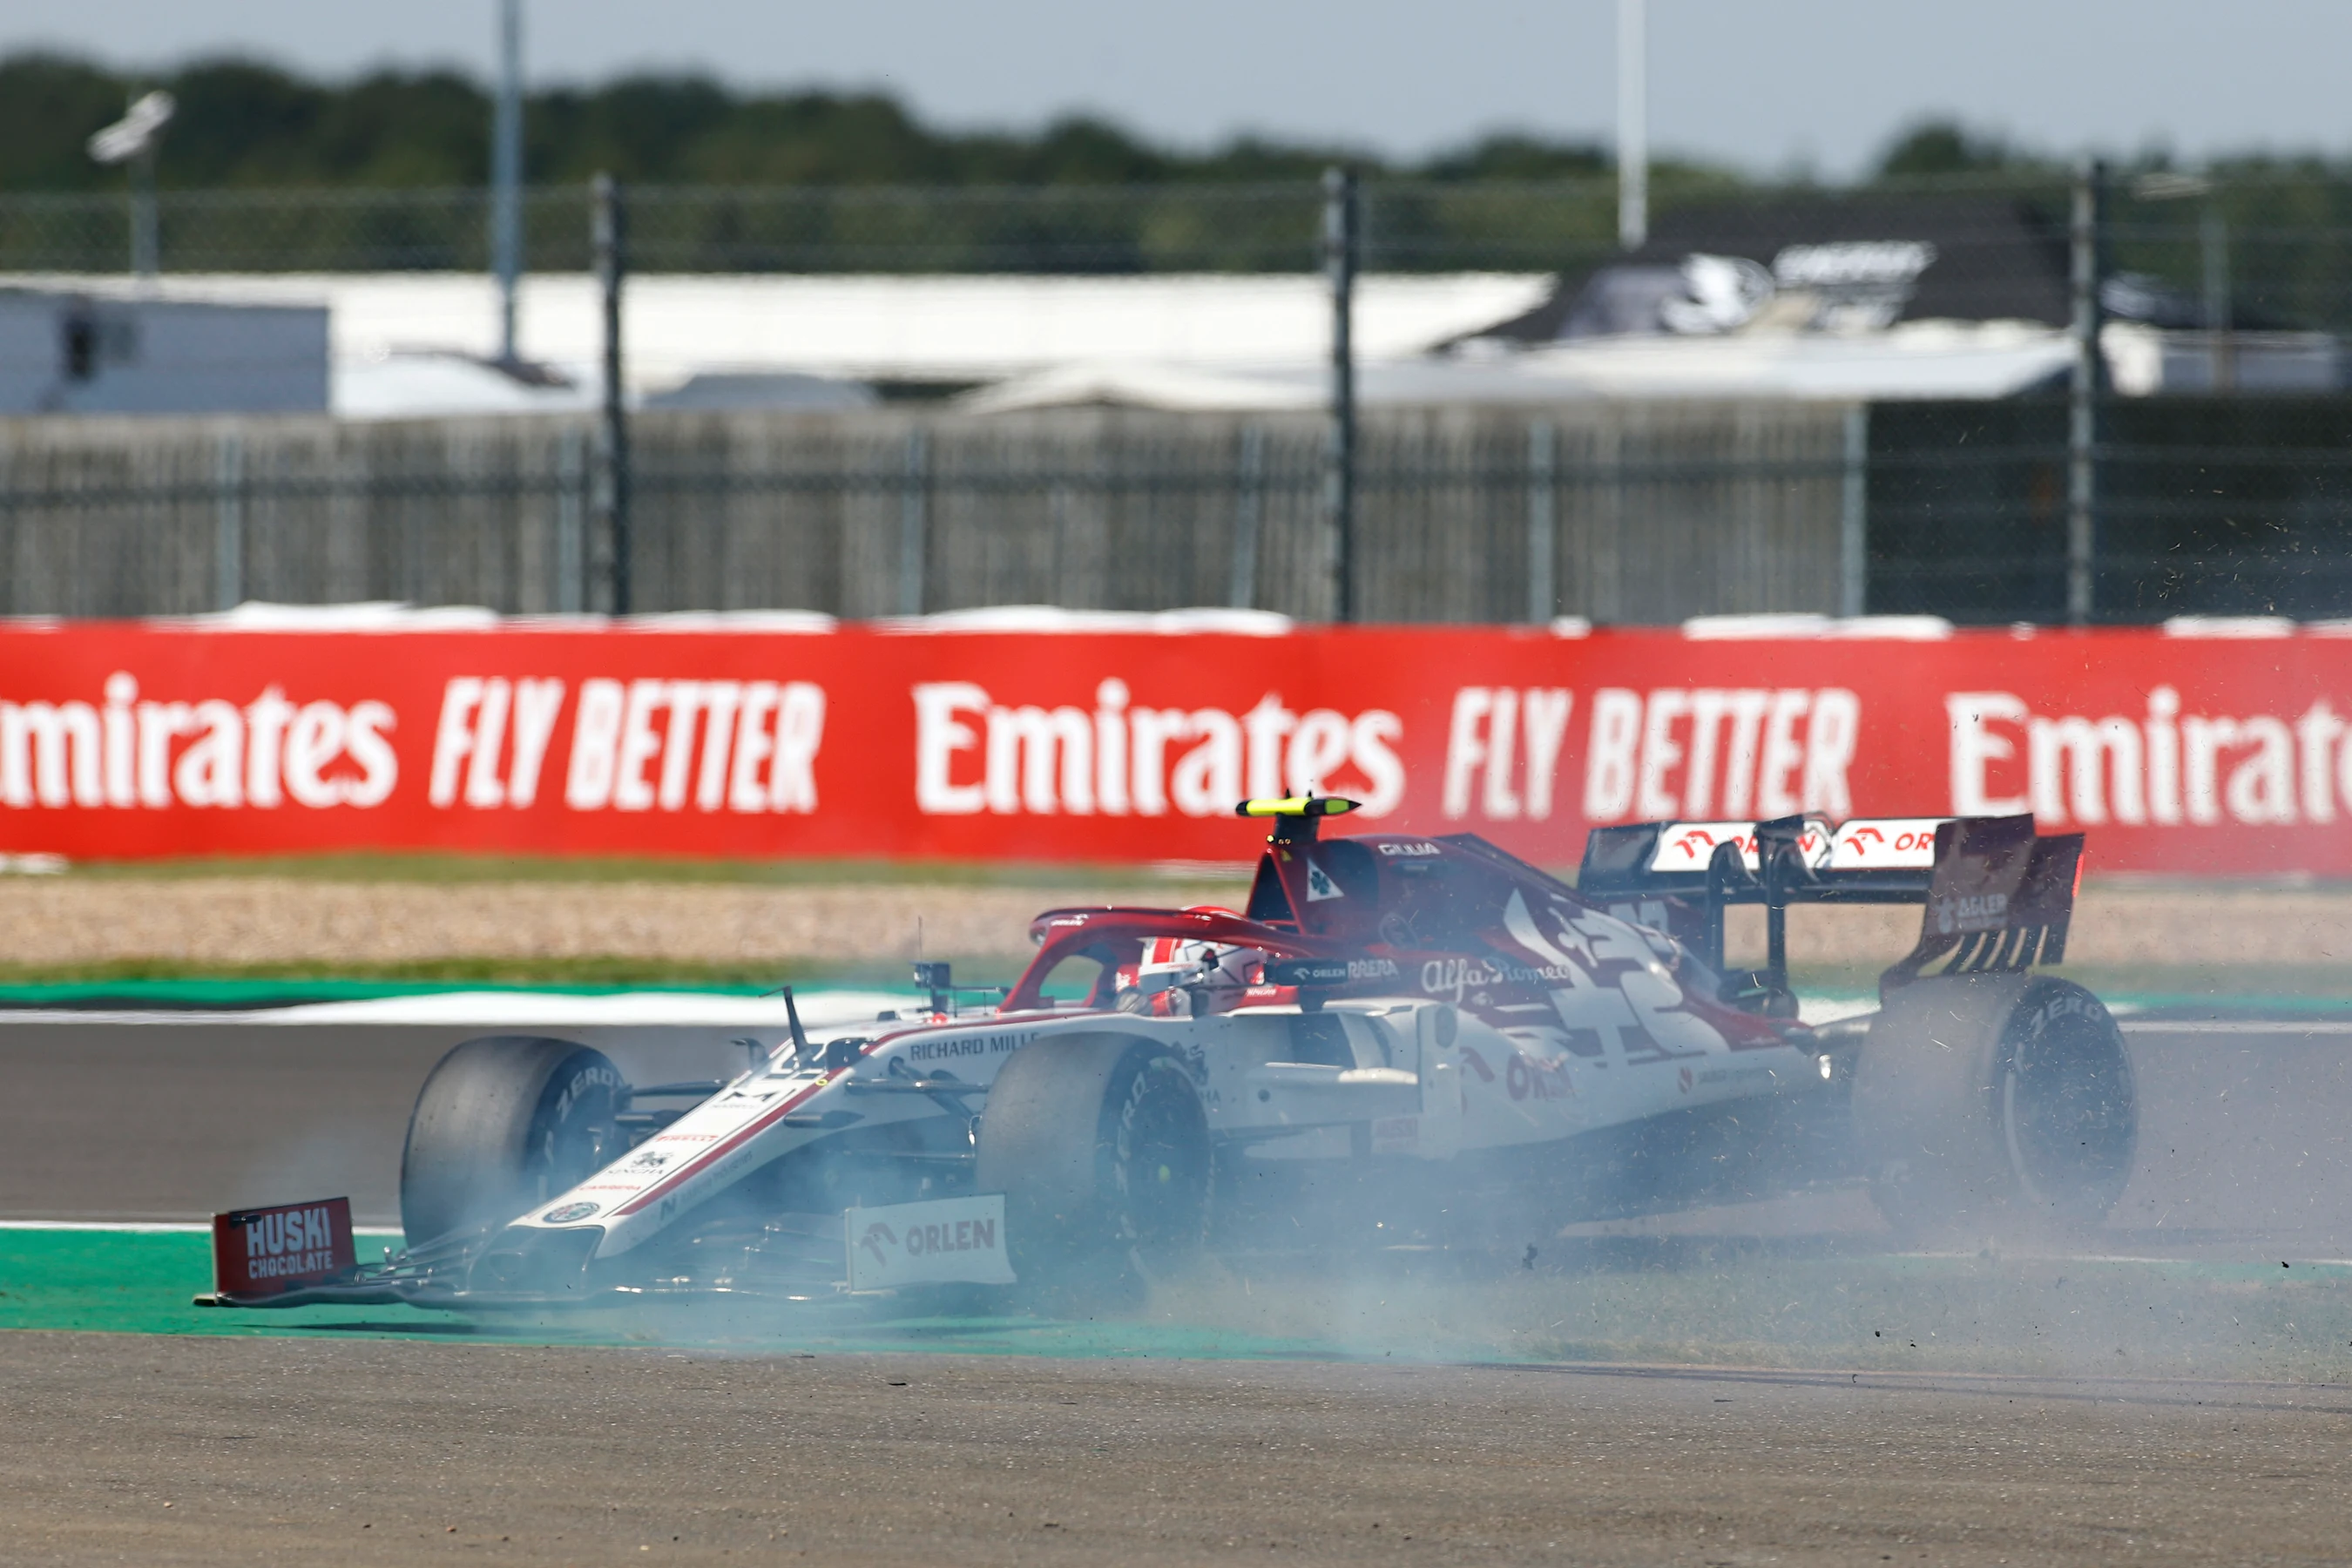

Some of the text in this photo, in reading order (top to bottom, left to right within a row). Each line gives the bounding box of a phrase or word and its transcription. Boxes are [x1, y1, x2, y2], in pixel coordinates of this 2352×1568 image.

[429, 674, 564, 810] FLY
[566, 678, 827, 814] BETTER
[912, 676, 1862, 821] Emirates FLY BETTER
[1378, 841, 1441, 857] GIULIA
[1313, 967, 1347, 978] ORLEN
[1421, 958, 1571, 1004] Alfa Romeo
[910, 1037, 985, 1061] RICHARD
[556, 1066, 614, 1125] ZERO
[245, 1206, 333, 1258] HUSKI
[906, 1218, 996, 1257] ORLEN
[248, 1251, 334, 1280] CHOCOLATE
